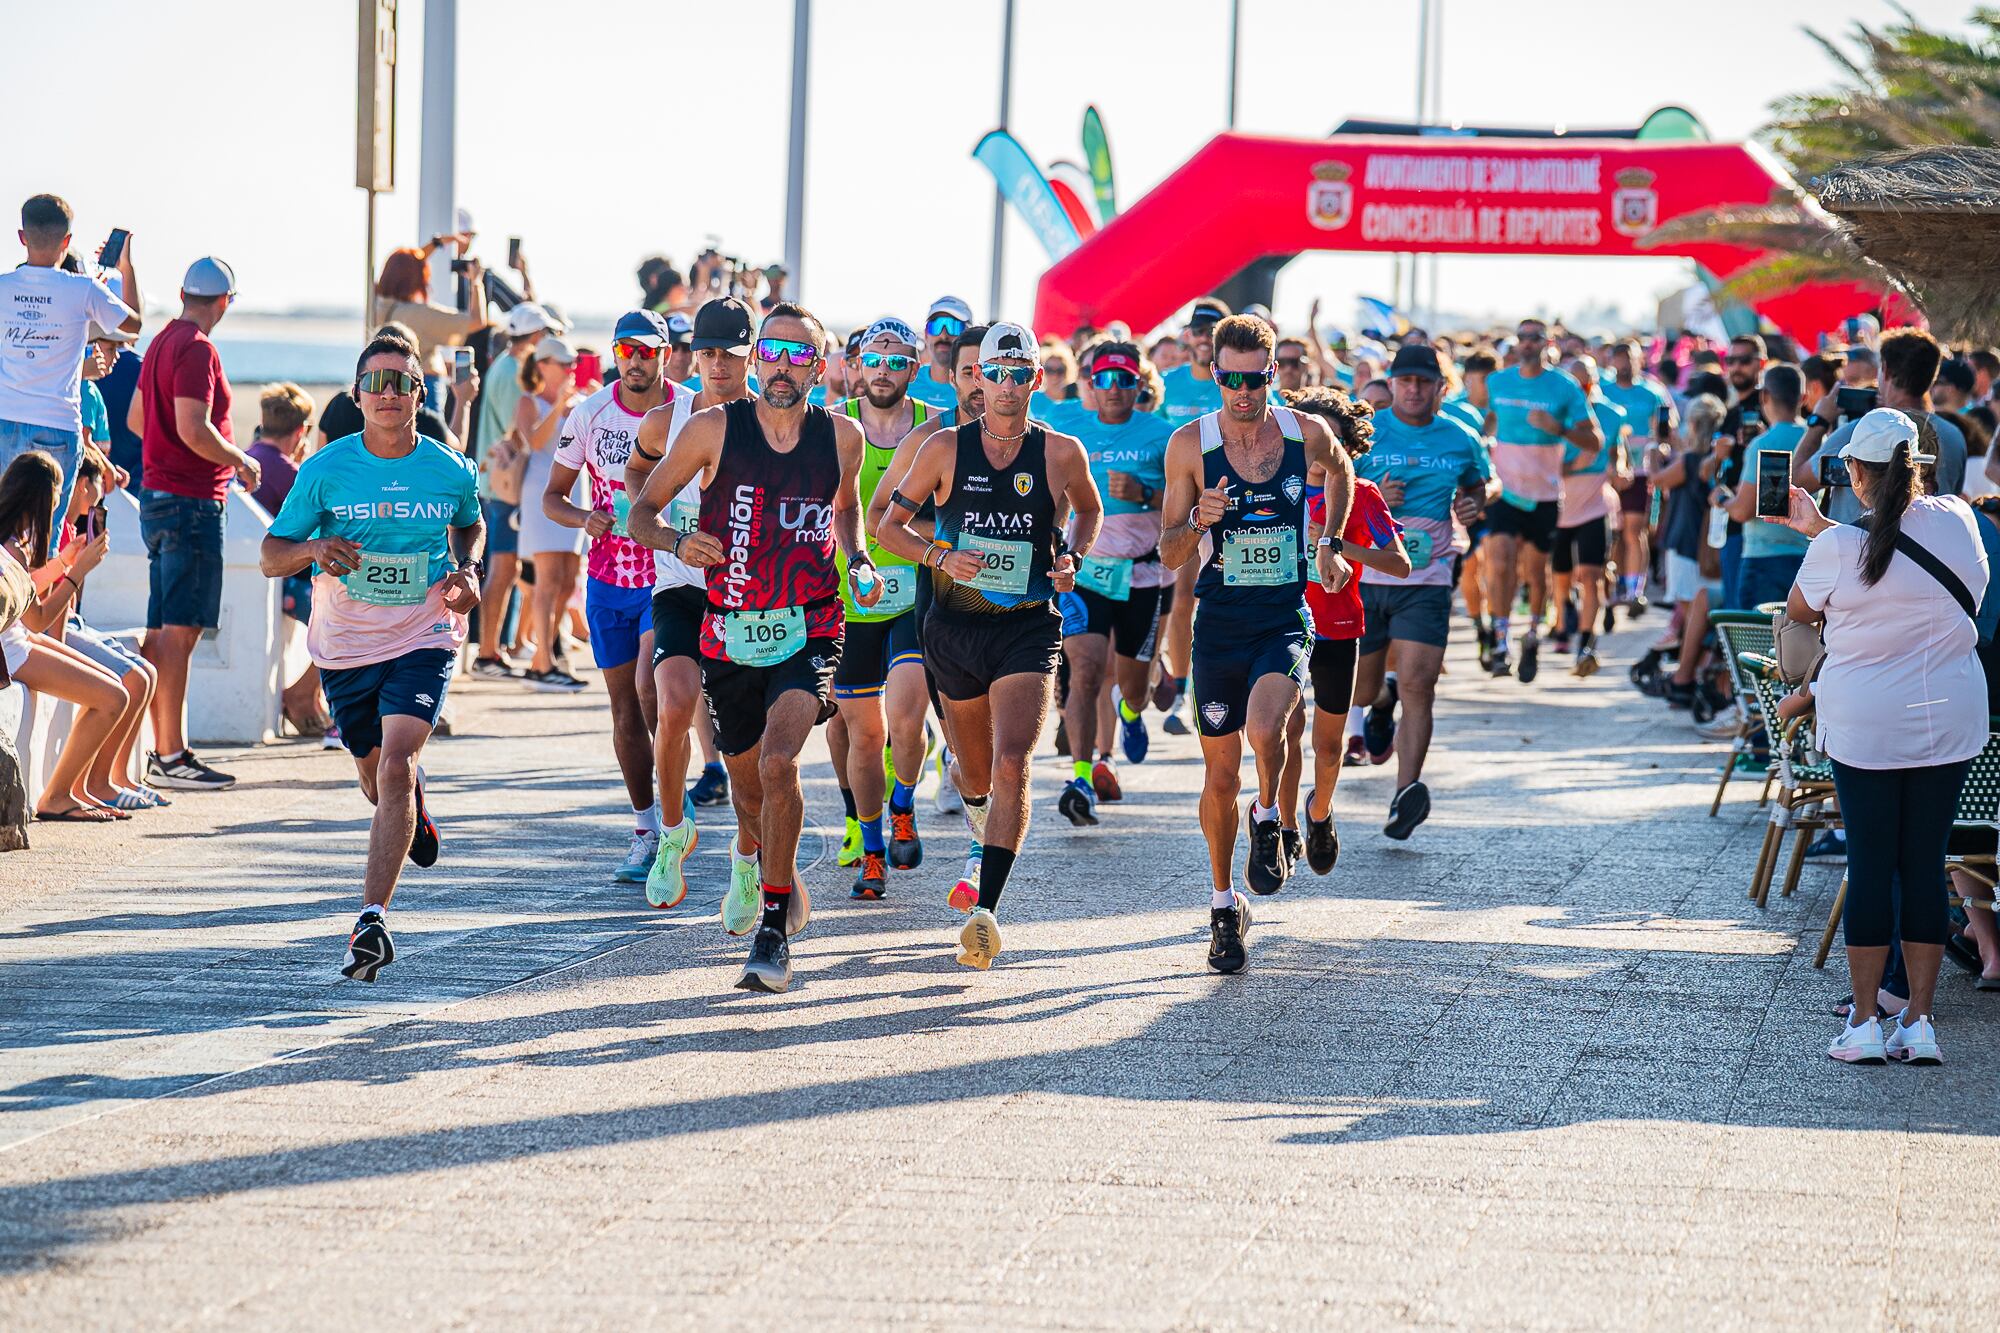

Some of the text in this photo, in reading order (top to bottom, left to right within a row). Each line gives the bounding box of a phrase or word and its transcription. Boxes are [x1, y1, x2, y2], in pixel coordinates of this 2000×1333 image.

[1470, 156, 1488, 192] DE
[1489, 157, 1516, 193] SAN
[1360, 198, 1602, 246] CONCEJALÍA DE DEPORTES
[597, 449, 631, 467] Sueñ
[332, 502, 442, 519] FISIOSAN
[750, 487, 765, 547] eventos
[964, 511, 1033, 528] PLAYAS
[723, 484, 755, 608] tripasión
[1240, 546, 1281, 565] 189
[366, 565, 411, 585] 231
[373, 587, 402, 595] Papeleta
[743, 623, 788, 643] 106
